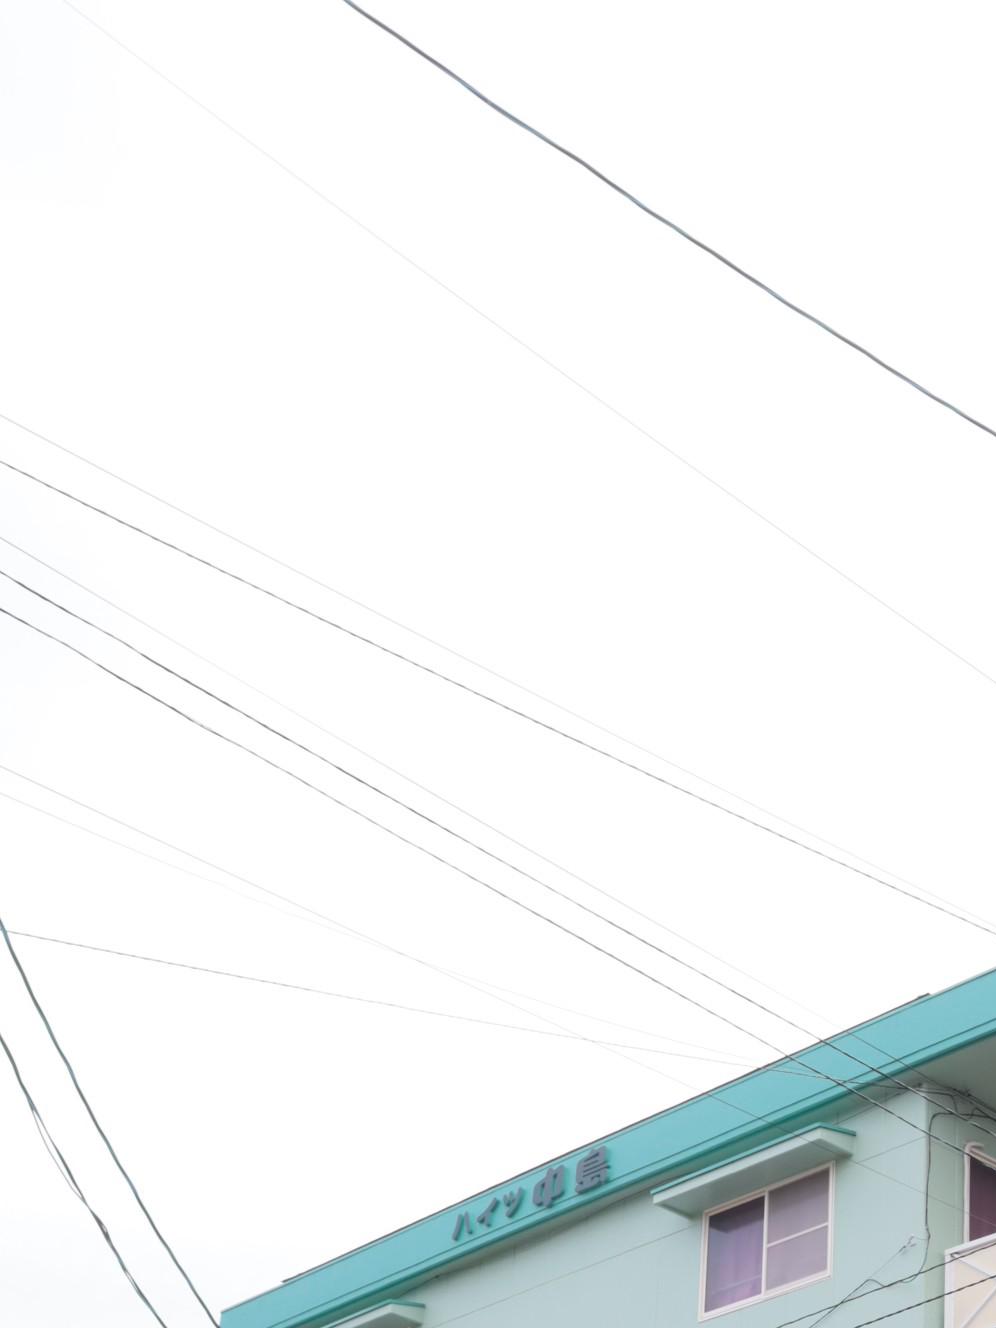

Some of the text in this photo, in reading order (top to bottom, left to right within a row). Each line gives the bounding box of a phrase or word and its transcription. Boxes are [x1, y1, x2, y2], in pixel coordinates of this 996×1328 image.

[452, 1145, 610, 1241] ハイツ中島
